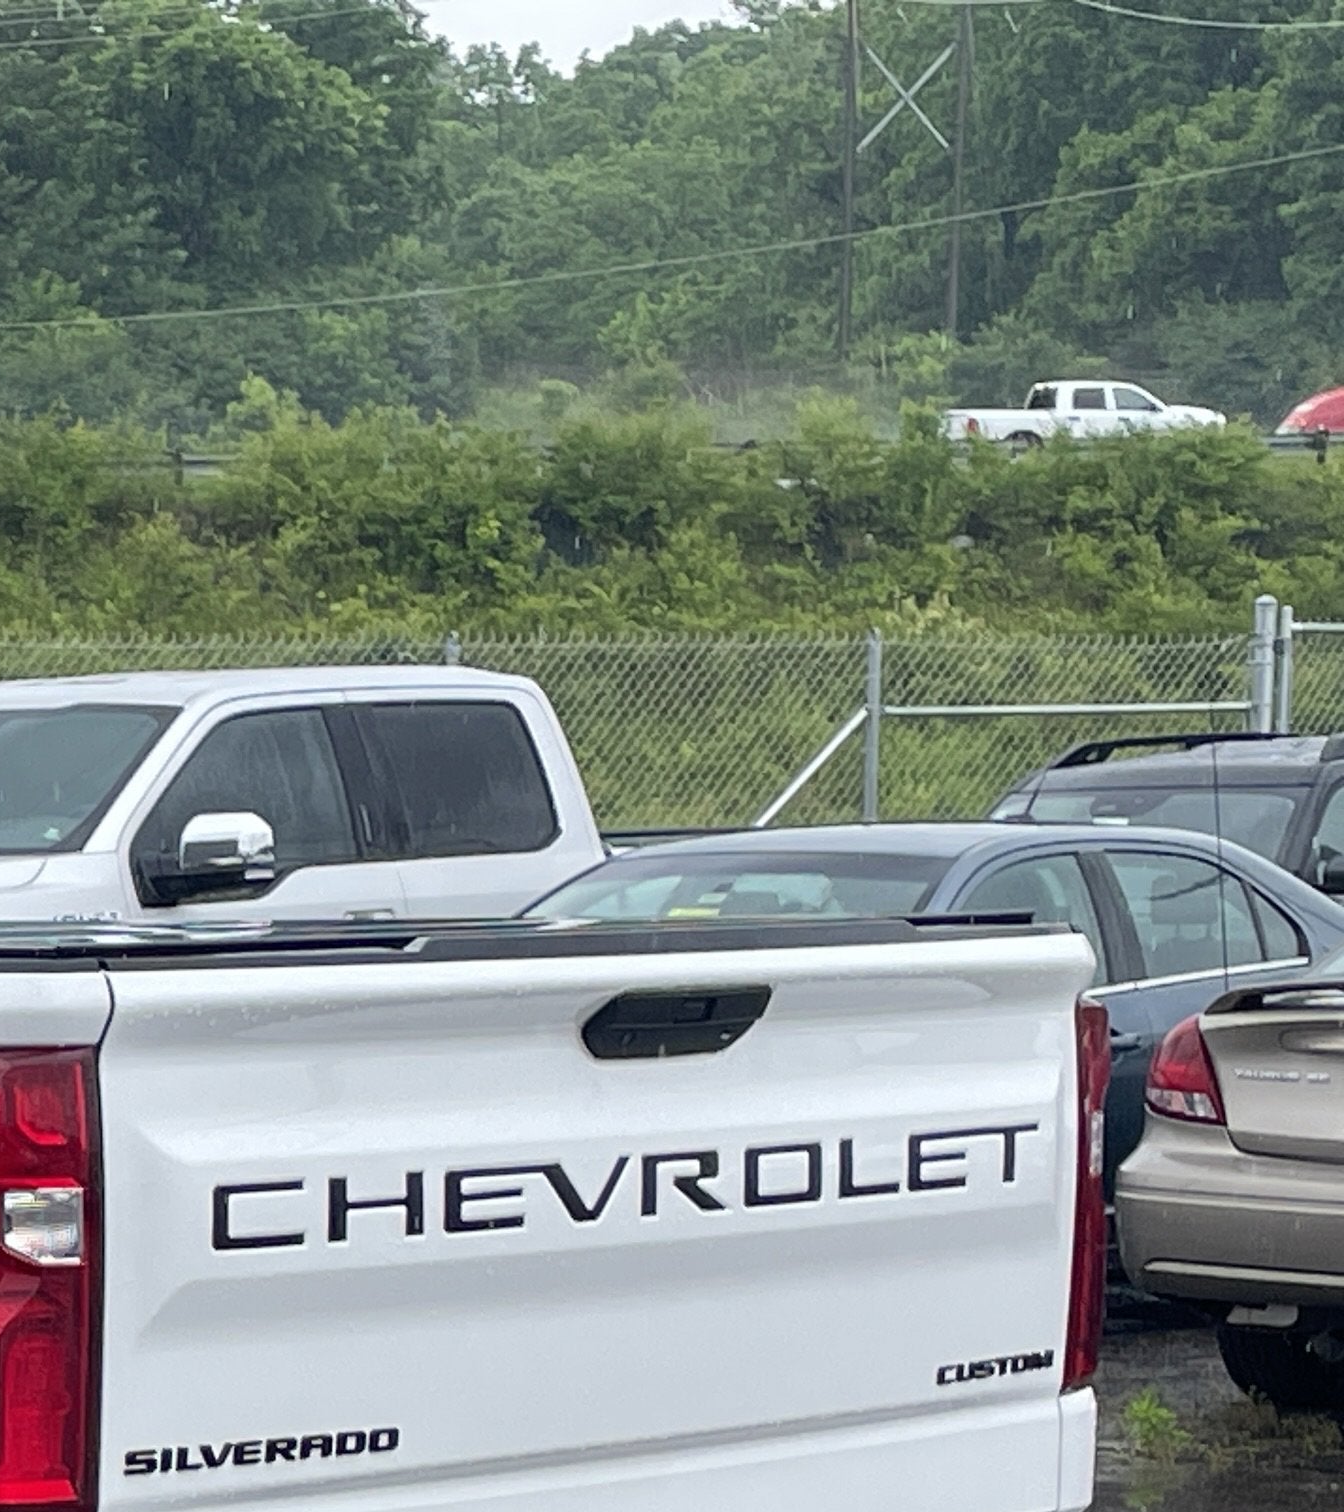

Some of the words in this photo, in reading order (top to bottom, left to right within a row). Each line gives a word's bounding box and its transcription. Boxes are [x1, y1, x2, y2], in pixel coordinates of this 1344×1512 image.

[210, 1122, 1041, 1252] CHEVROLET
[936, 1349, 1054, 1386] CUSTOM
[123, 1427, 400, 1477] SILVERADO
